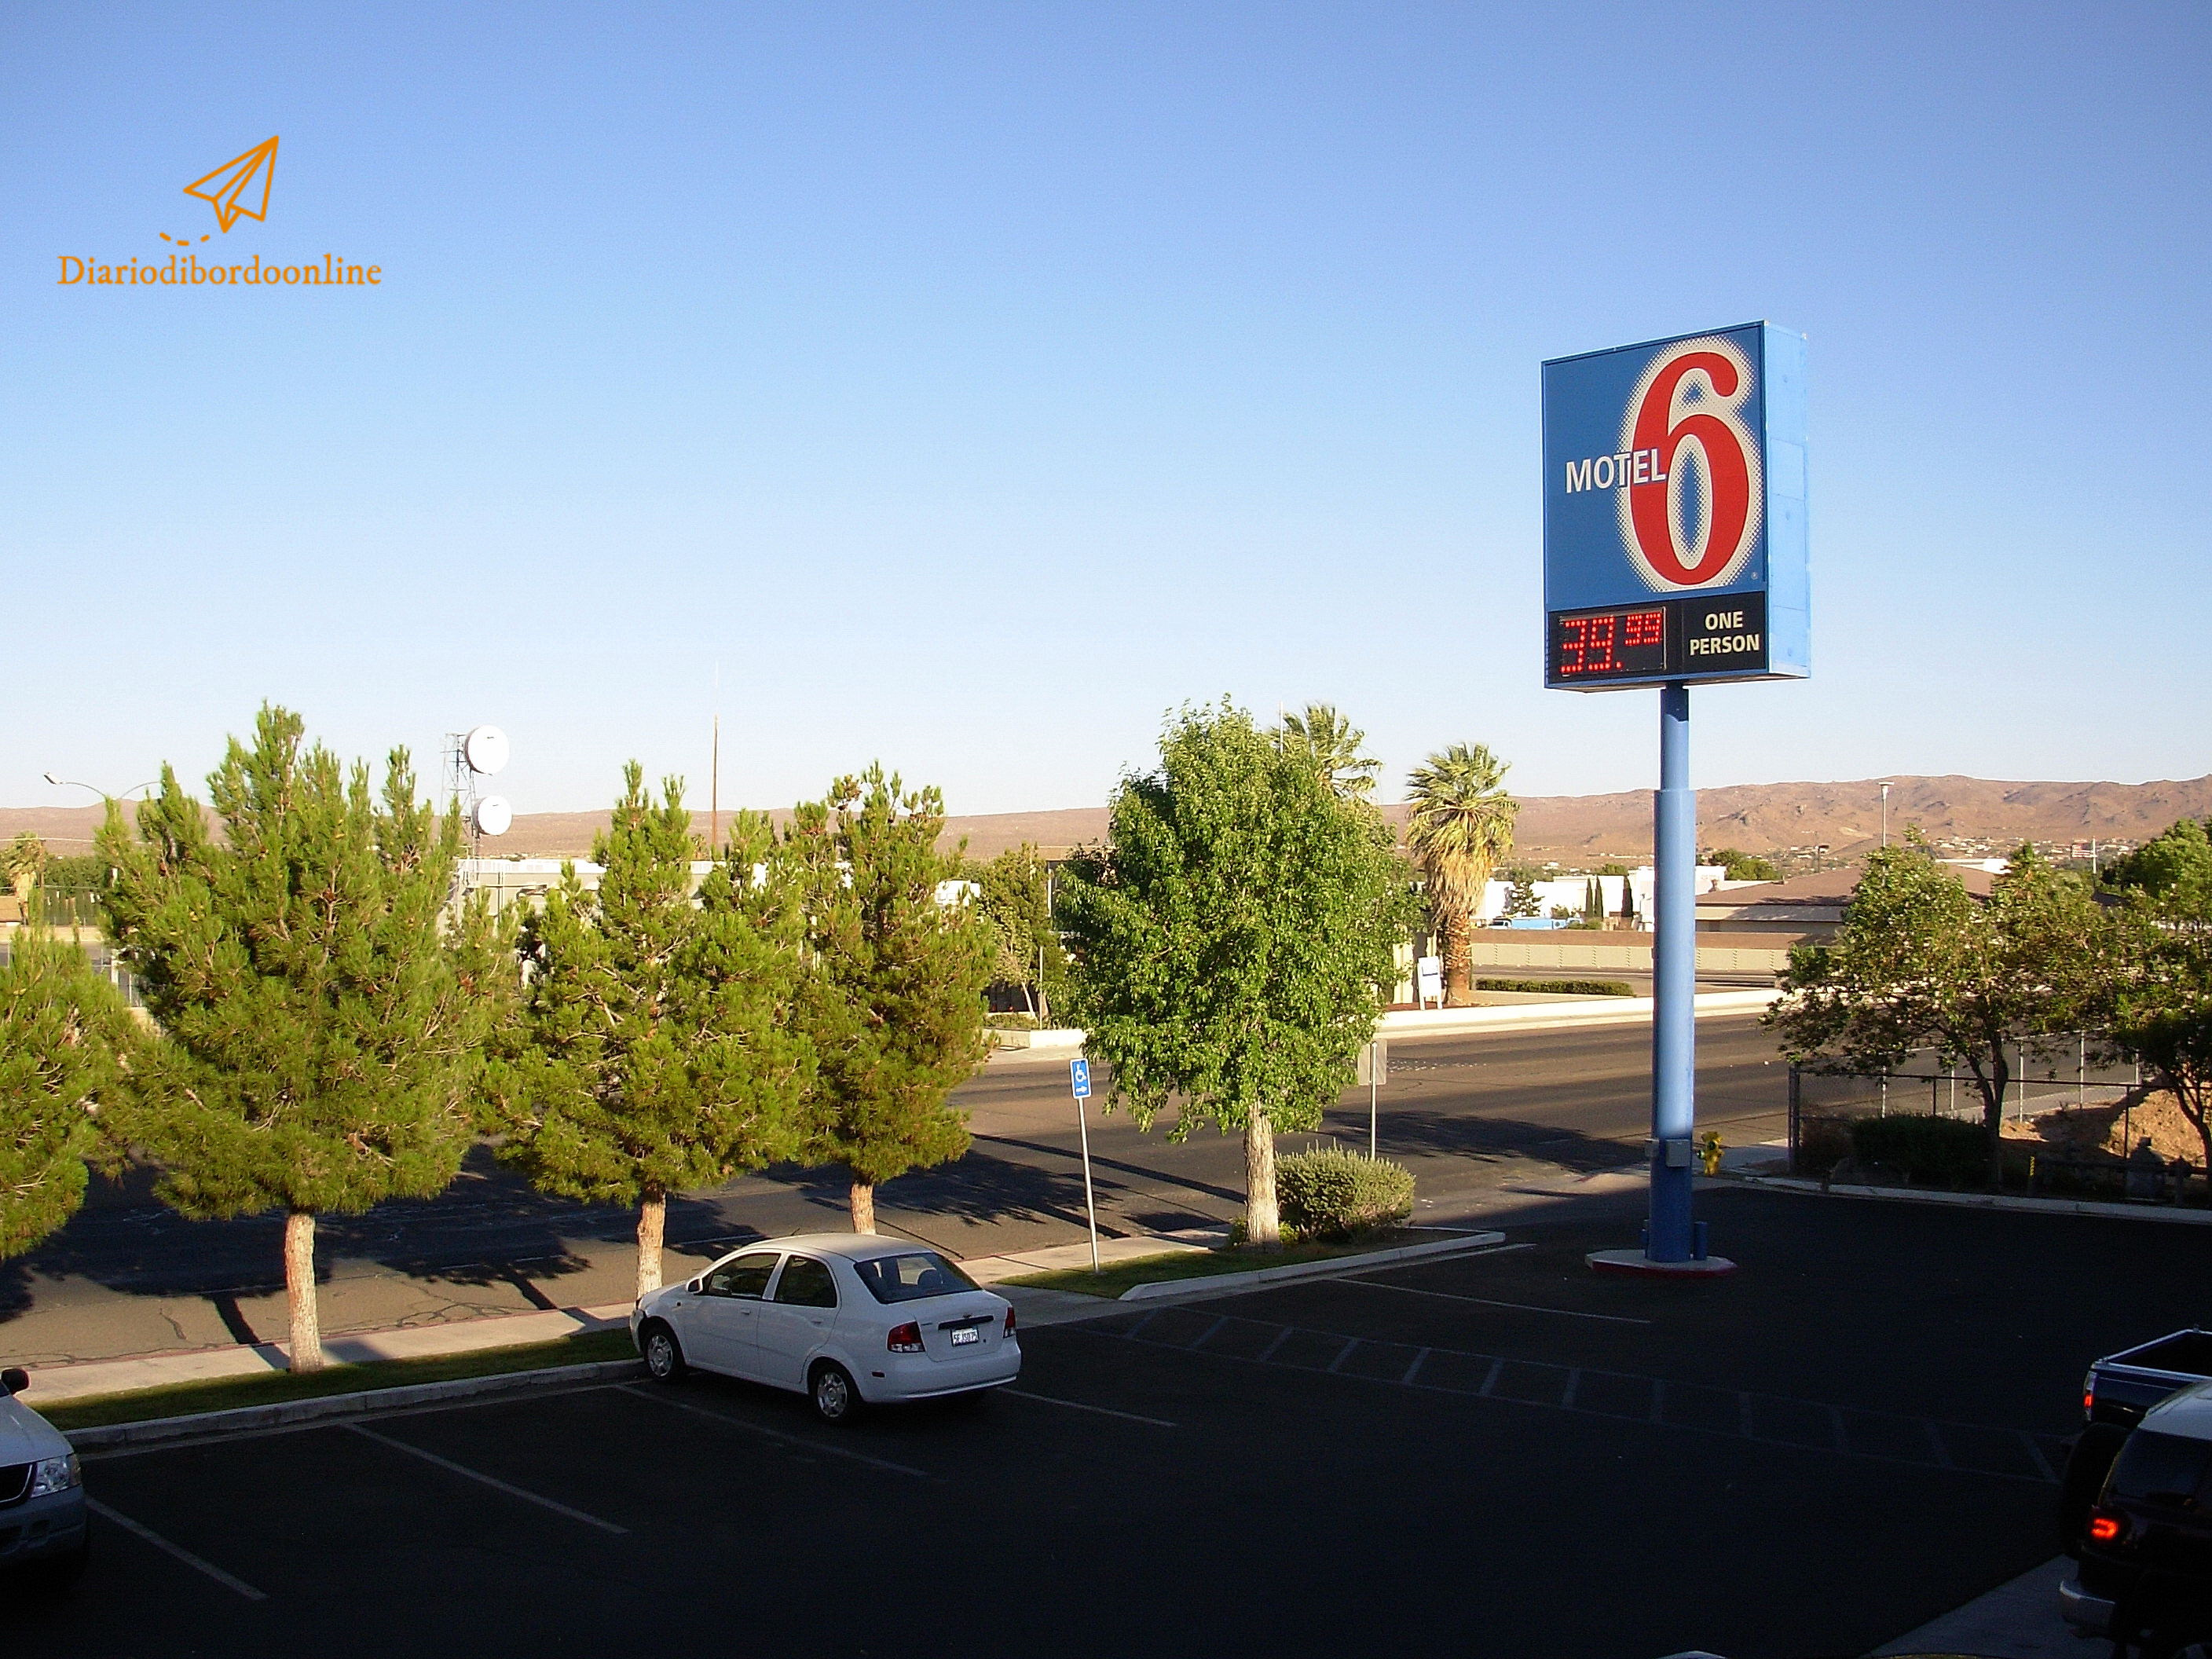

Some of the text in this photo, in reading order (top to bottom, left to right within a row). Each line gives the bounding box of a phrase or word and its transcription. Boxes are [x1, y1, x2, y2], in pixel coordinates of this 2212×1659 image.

[1565, 351, 1750, 586] MOTEL 6
[1705, 610, 1744, 631] ONE
[1690, 633, 1760, 656] PERSON
